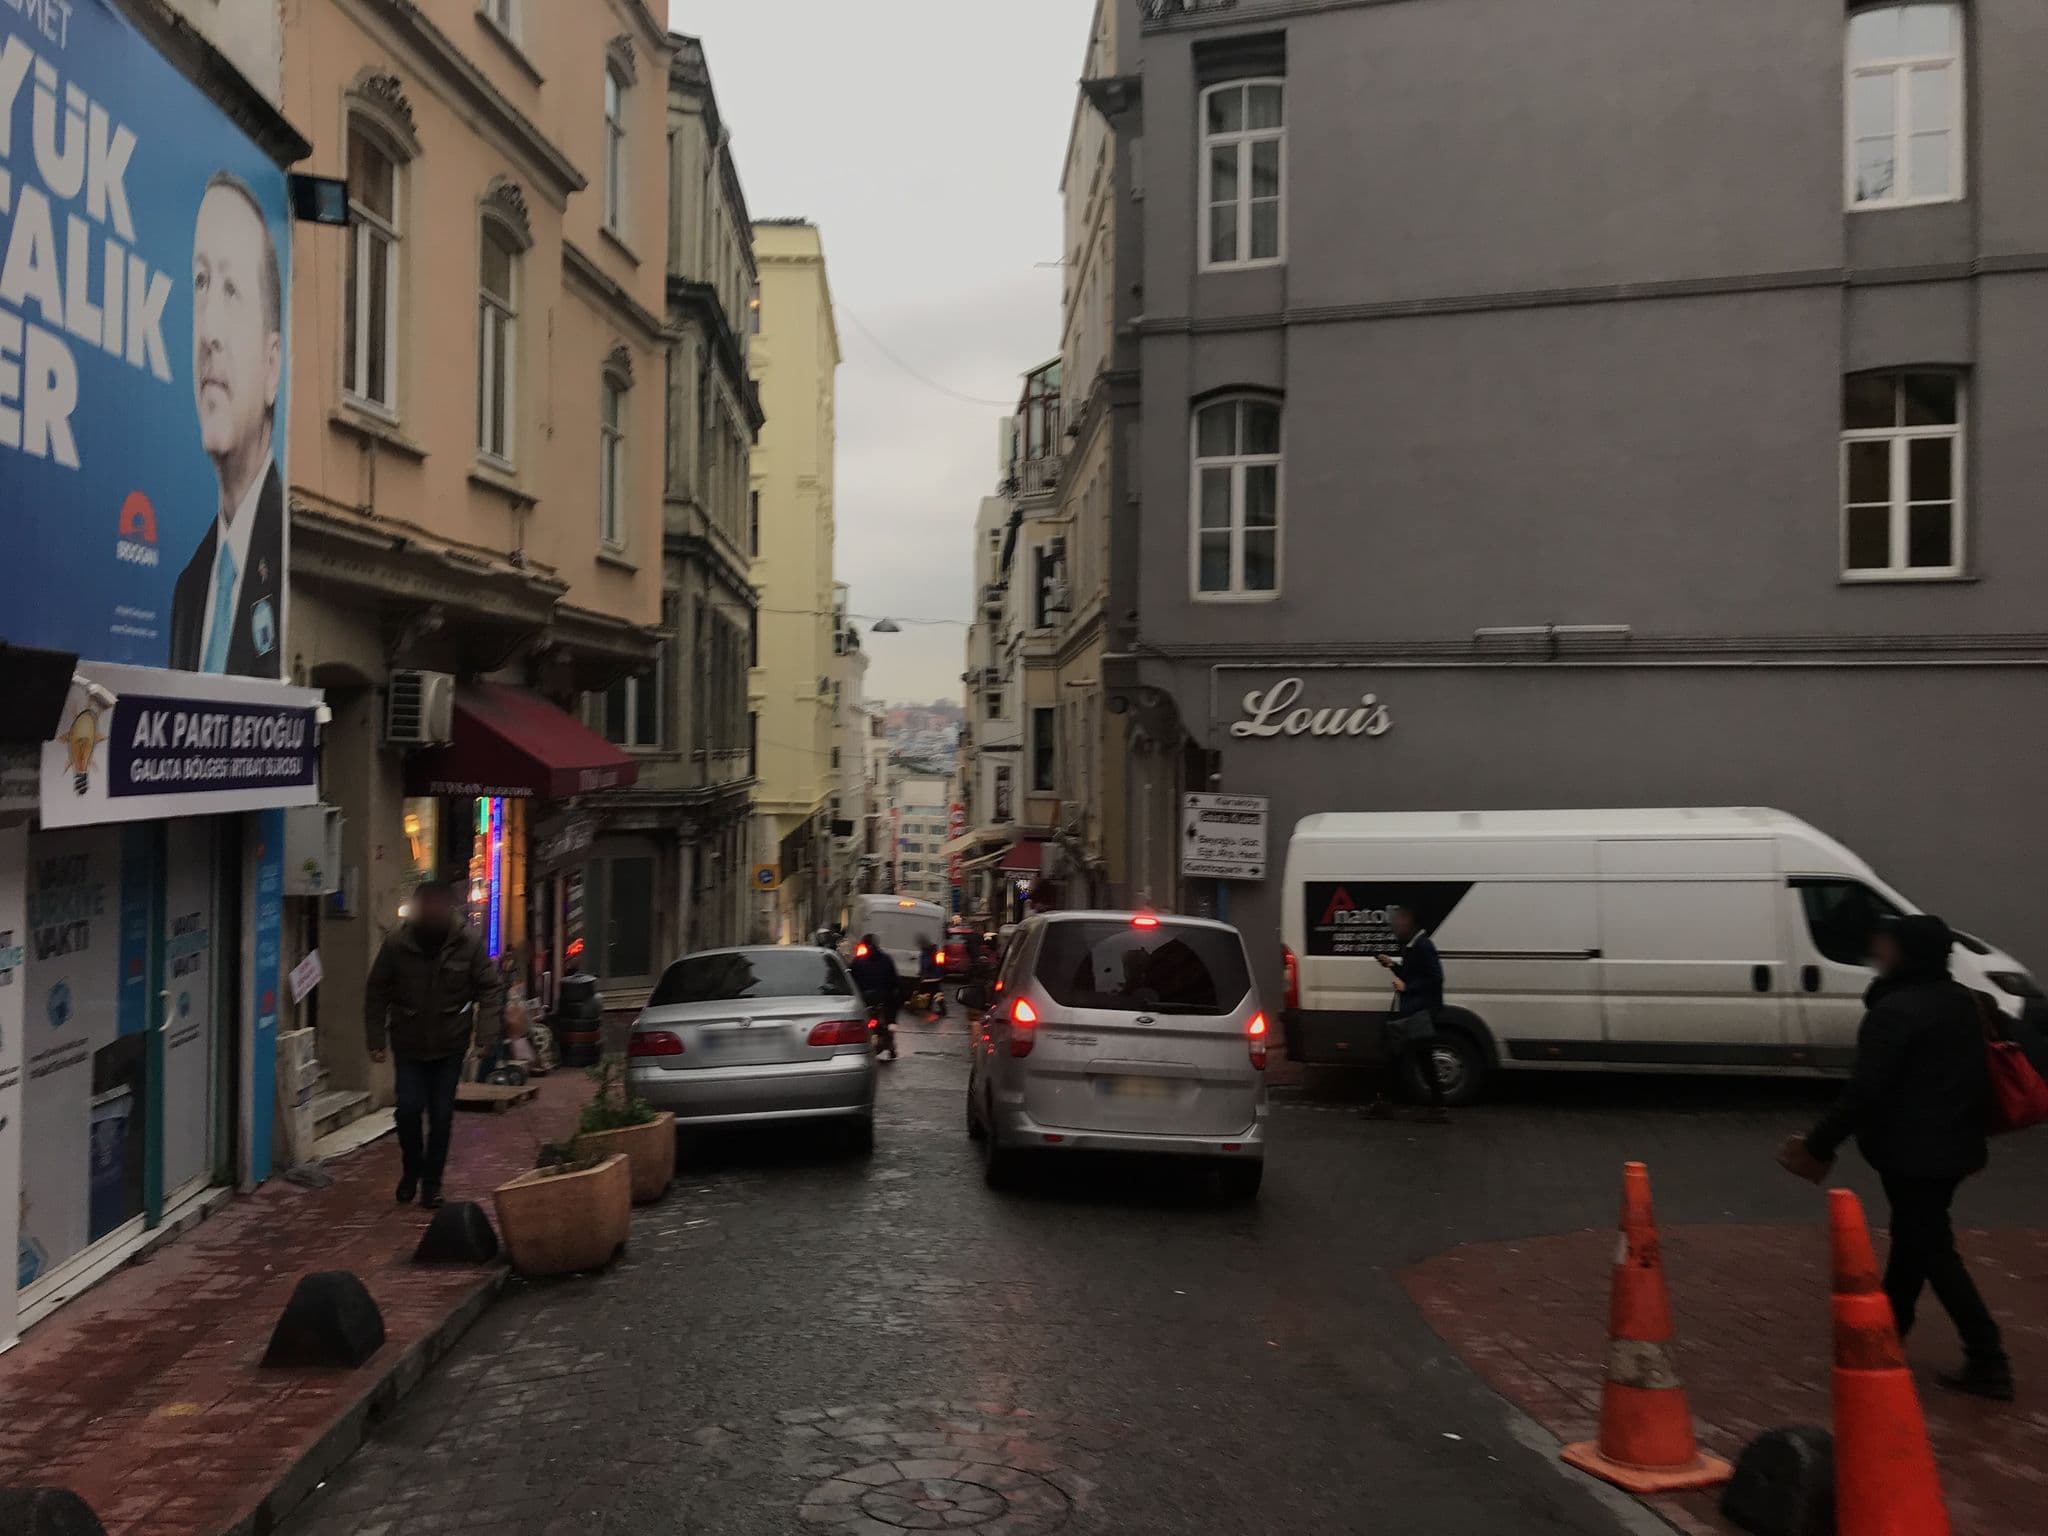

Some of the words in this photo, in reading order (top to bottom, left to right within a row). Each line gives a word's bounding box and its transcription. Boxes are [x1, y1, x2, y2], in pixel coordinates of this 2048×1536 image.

[8, 0, 74, 51] MET
[0, 165, 174, 385] ALIK
[131, 710, 170, 749] AK
[230, 713, 307, 750] BEYOĞLU
[1230, 677, 1394, 737] Louis
[130, 757, 183, 783] GALATA
